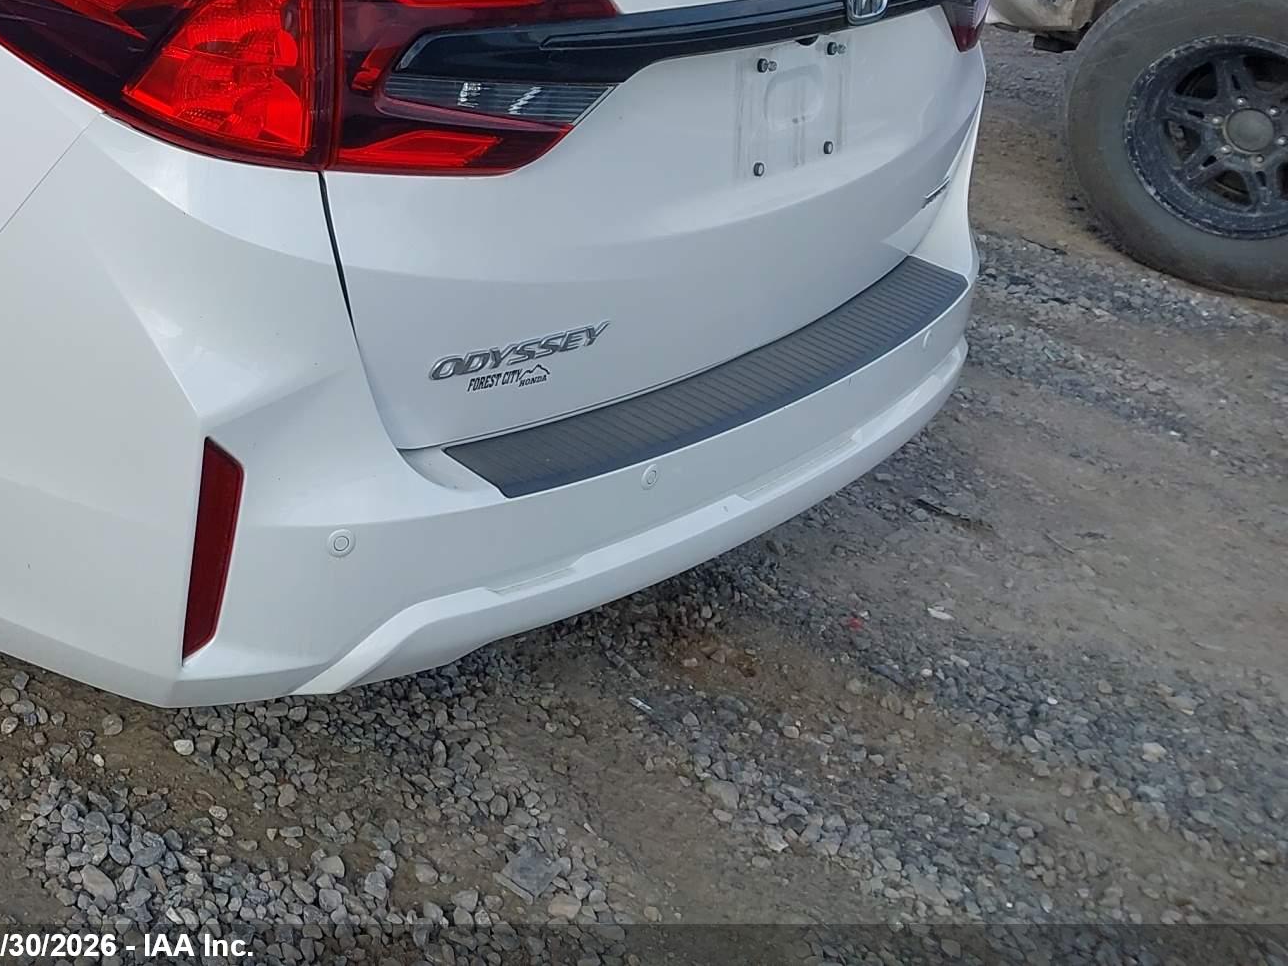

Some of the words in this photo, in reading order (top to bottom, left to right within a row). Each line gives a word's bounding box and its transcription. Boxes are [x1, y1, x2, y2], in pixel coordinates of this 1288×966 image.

[429, 320, 611, 381] ODYSSEY
[467, 374, 502, 392] FOREST
[501, 369, 522, 385] CITY
[518, 374, 548, 387] HONDA
